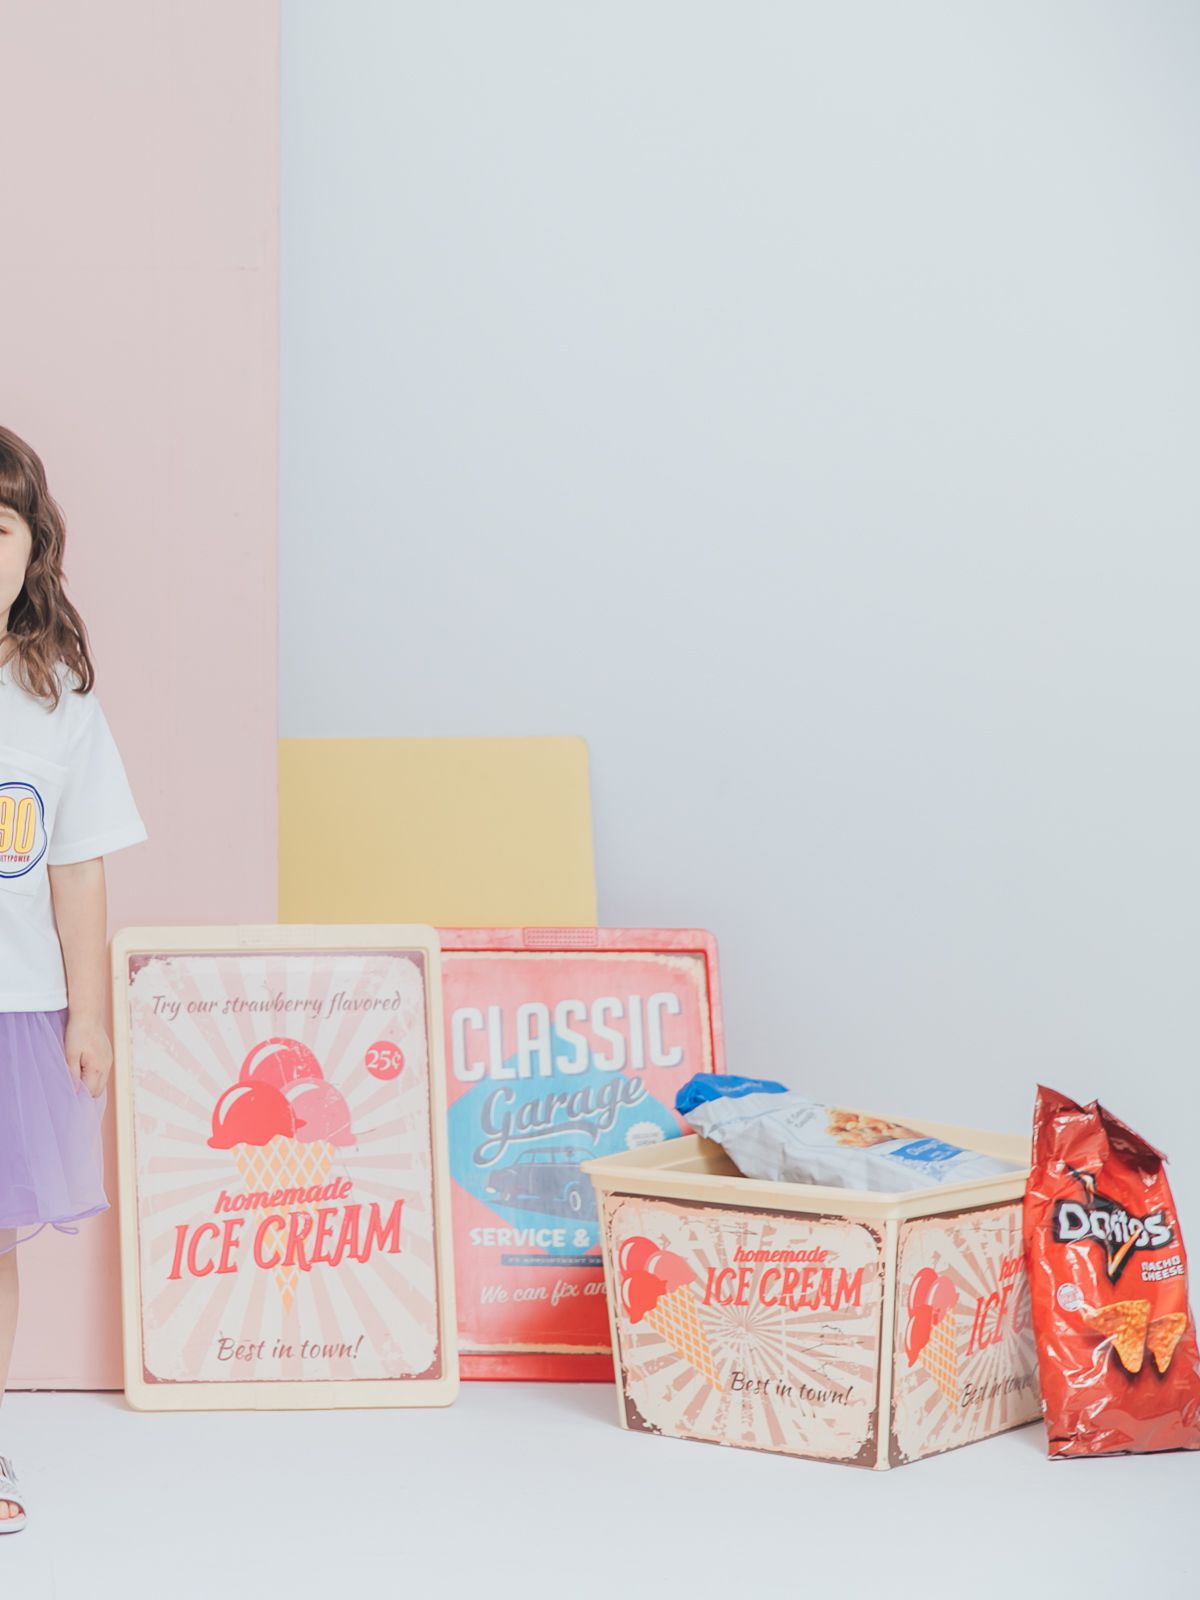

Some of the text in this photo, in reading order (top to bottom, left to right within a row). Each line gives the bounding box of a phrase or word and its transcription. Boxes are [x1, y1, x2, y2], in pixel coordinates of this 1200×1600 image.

[152, 991, 402, 1021] Try our strawberry flavored
[451, 991, 684, 1082] CLASSIC
[366, 1049, 402, 1071] 25¢
[476, 1076, 648, 1152] Garage
[213, 1176, 353, 1215] homemade
[167, 1199, 405, 1280] ICE CREAM
[468, 1226, 590, 1248] SERVICE &
[1058, 1201, 1172, 1248] Doritos
[733, 1245, 829, 1264] homemade
[1141, 1254, 1181, 1272] NACHO
[1141, 1264, 1185, 1282] CHEESE
[480, 1285, 508, 1304] We
[513, 1285, 549, 1302] can
[552, 1279, 579, 1307] fix
[702, 1266, 866, 1312] ICE CREAM
[966, 1283, 1014, 1357] ICE
[217, 1335, 365, 1361] Best in town!
[730, 1371, 854, 1406] Best in town!
[961, 1382, 989, 1408] Best
